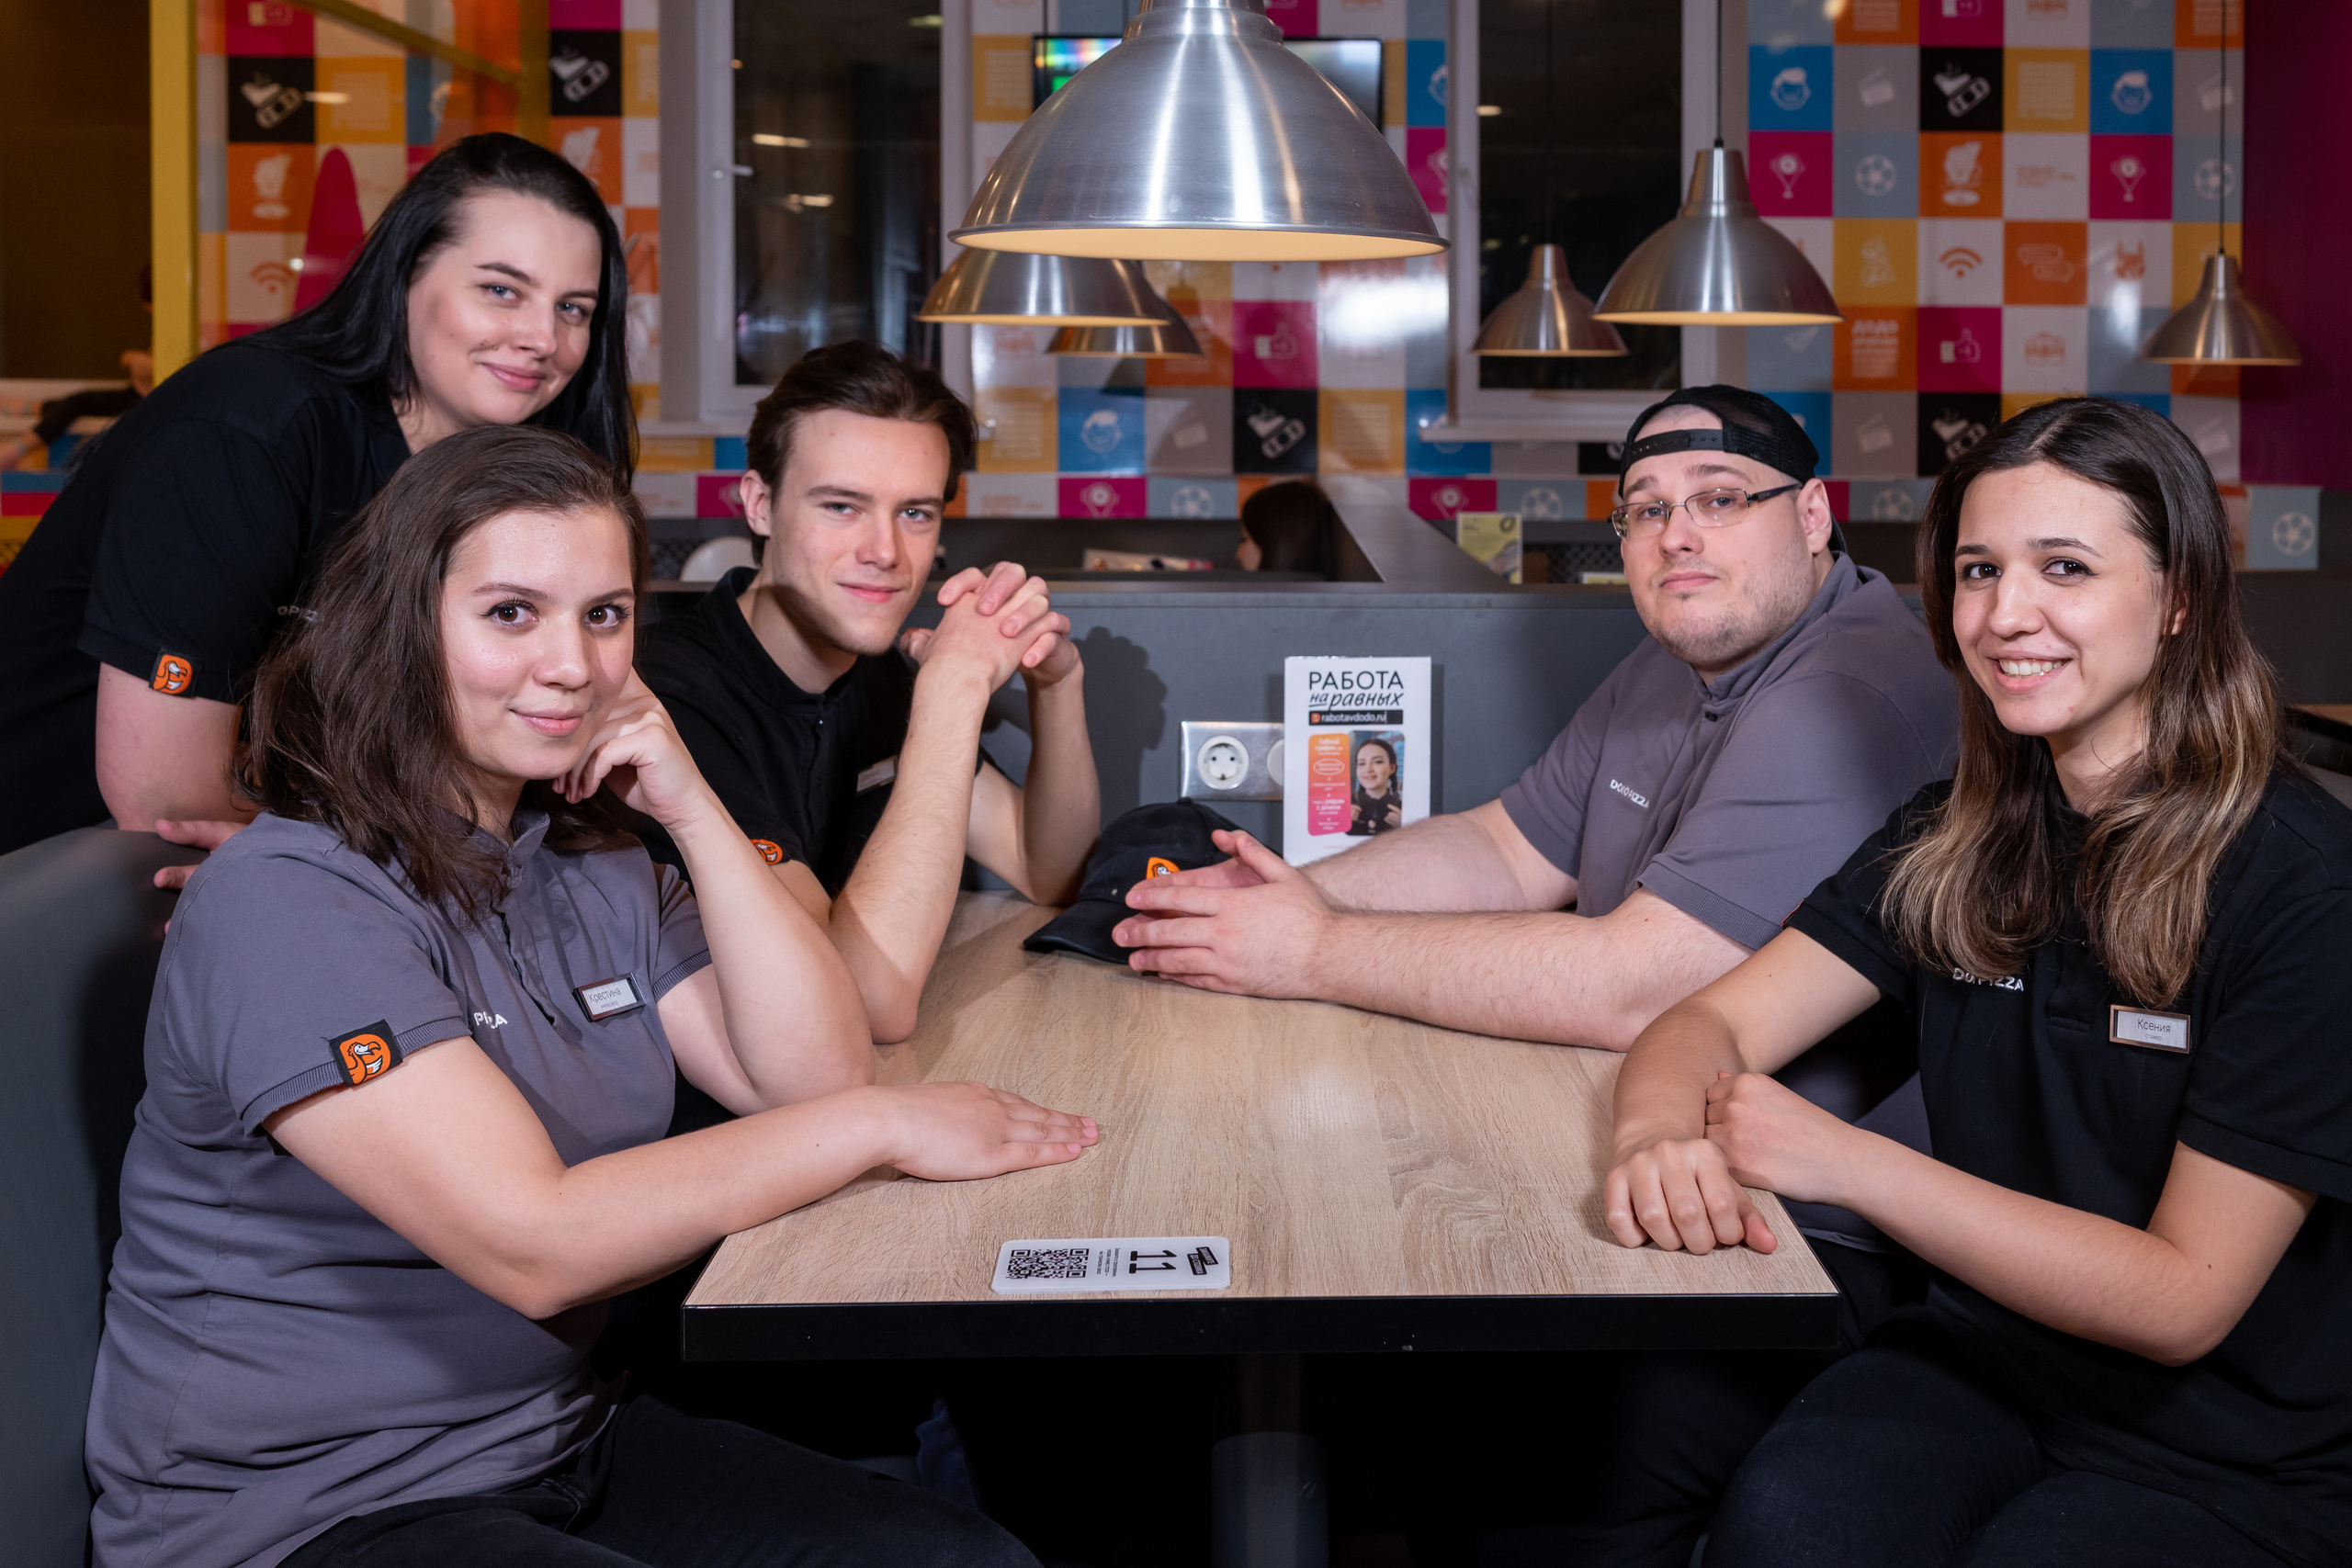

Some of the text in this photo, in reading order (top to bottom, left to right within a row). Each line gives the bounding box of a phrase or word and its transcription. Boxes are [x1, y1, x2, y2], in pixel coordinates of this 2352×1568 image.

[1309, 671, 1404, 690] РАБОТА
[1309, 693, 1404, 711] на равных
[1321, 712, 1386, 723] rabotavdodo.ru
[2137, 1019, 2171, 1033] Ксения
[1129, 1250, 1177, 1274] 11
